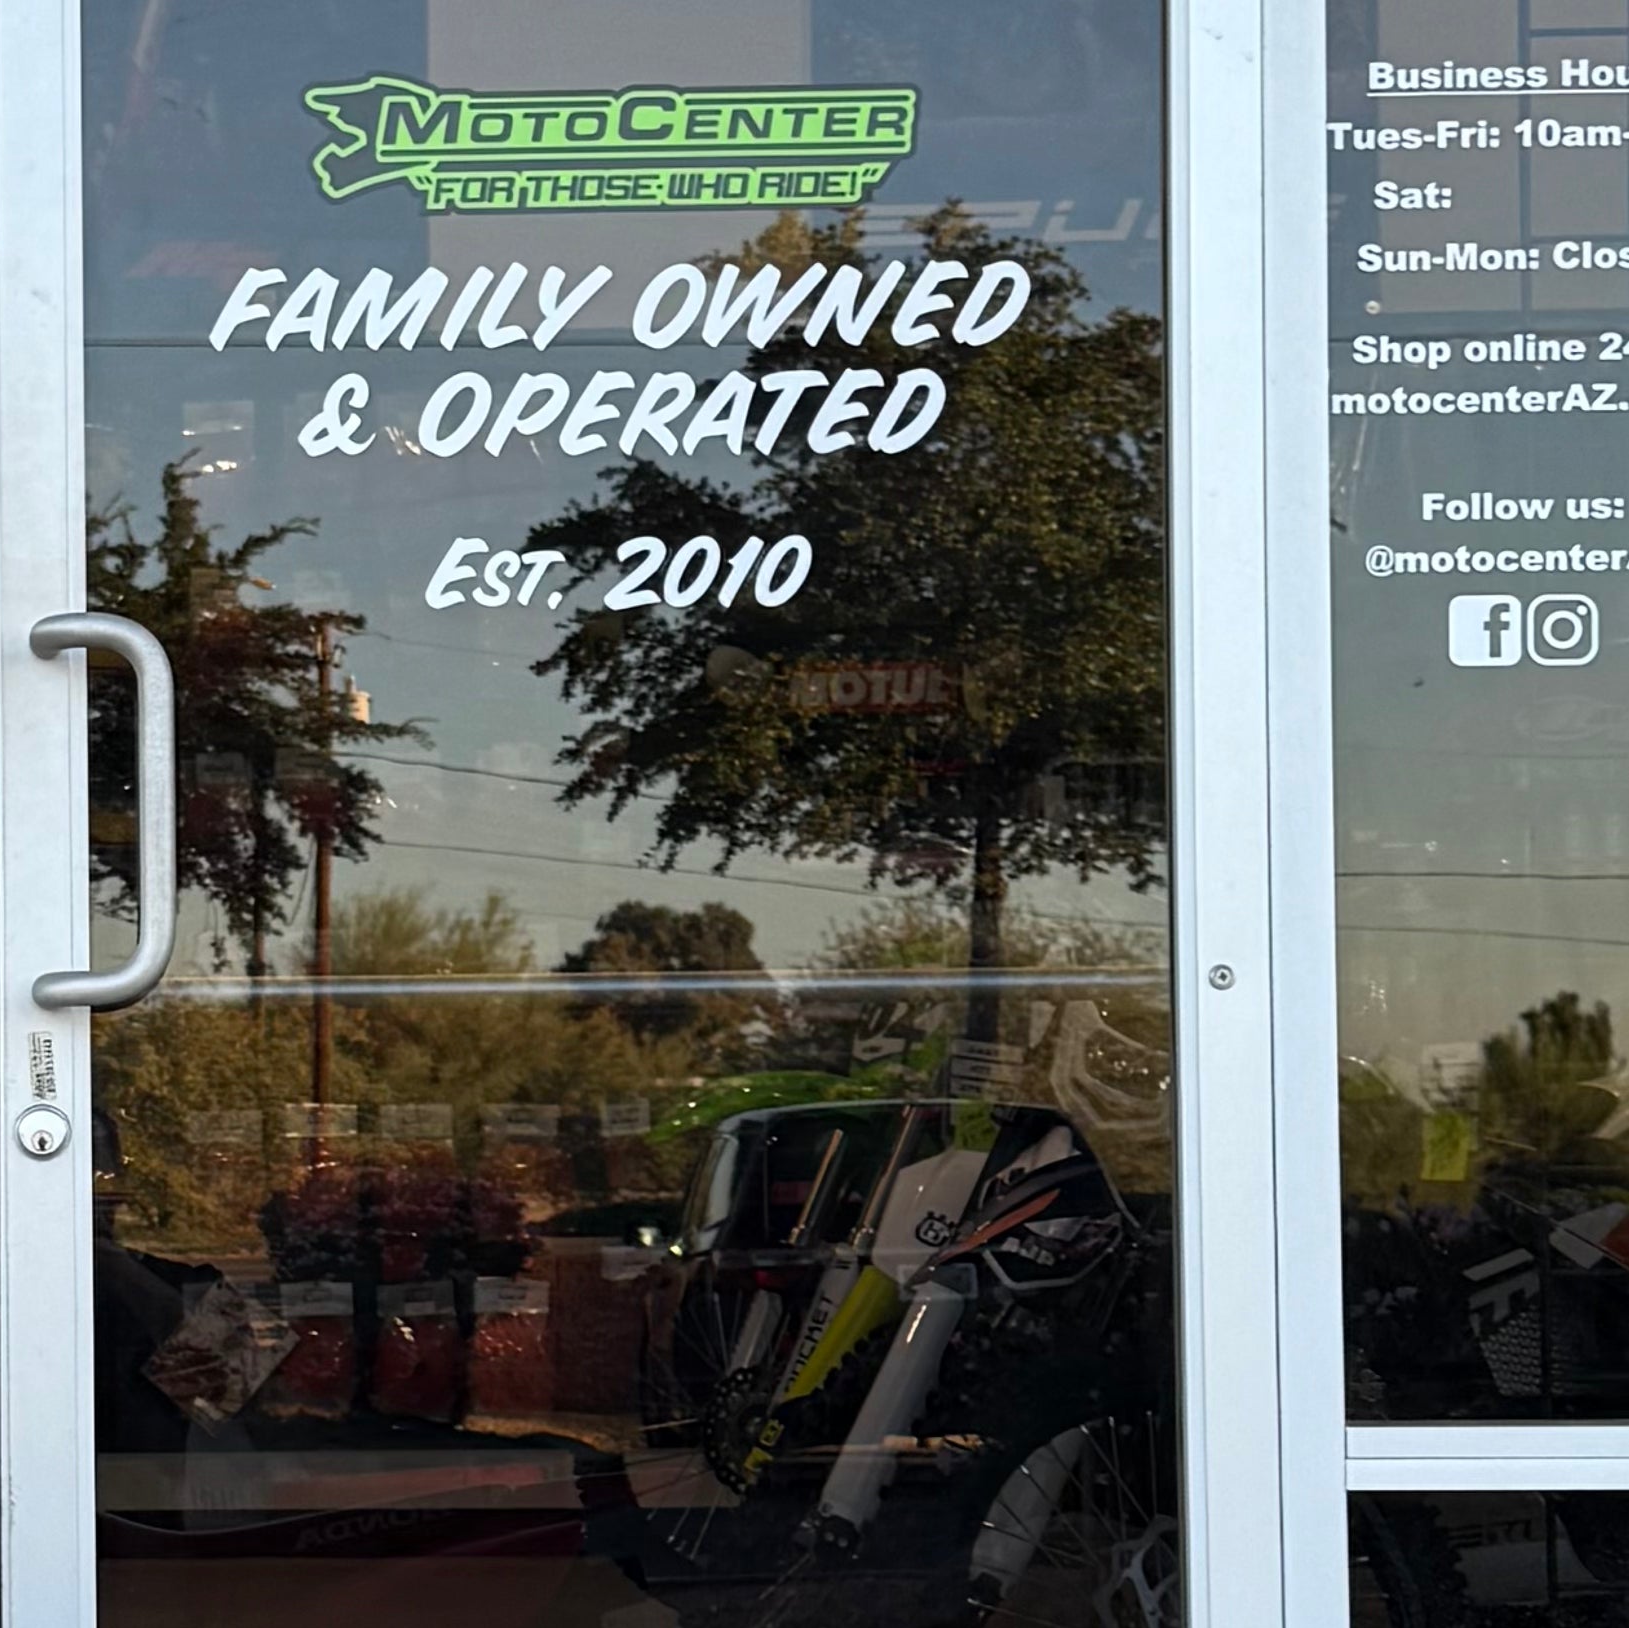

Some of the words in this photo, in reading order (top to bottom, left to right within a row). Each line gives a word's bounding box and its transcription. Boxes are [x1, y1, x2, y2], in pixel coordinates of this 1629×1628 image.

[1368, 60, 1549, 89] Business
[1328, 120, 1501, 150] Tues-Fri:
[669, 171, 750, 201] WHO
[1373, 180, 1452, 210] Sat:
[1357, 242, 1540, 273] Sun-Mon:
[208, 261, 613, 352] FAMILY
[632, 259, 1031, 349] OWNED
[1352, 335, 1452, 370] Shop
[1463, 333, 1587, 362] online
[297, 371, 377, 458] &
[417, 367, 946, 458] OPERATED
[1331, 383, 1629, 414] motocenterAZ.
[1422, 492, 1555, 521] Follow
[1566, 497, 1625, 520] us:
[603, 535, 812, 611] 2010
[1365, 543, 1629, 577] @motocenter
